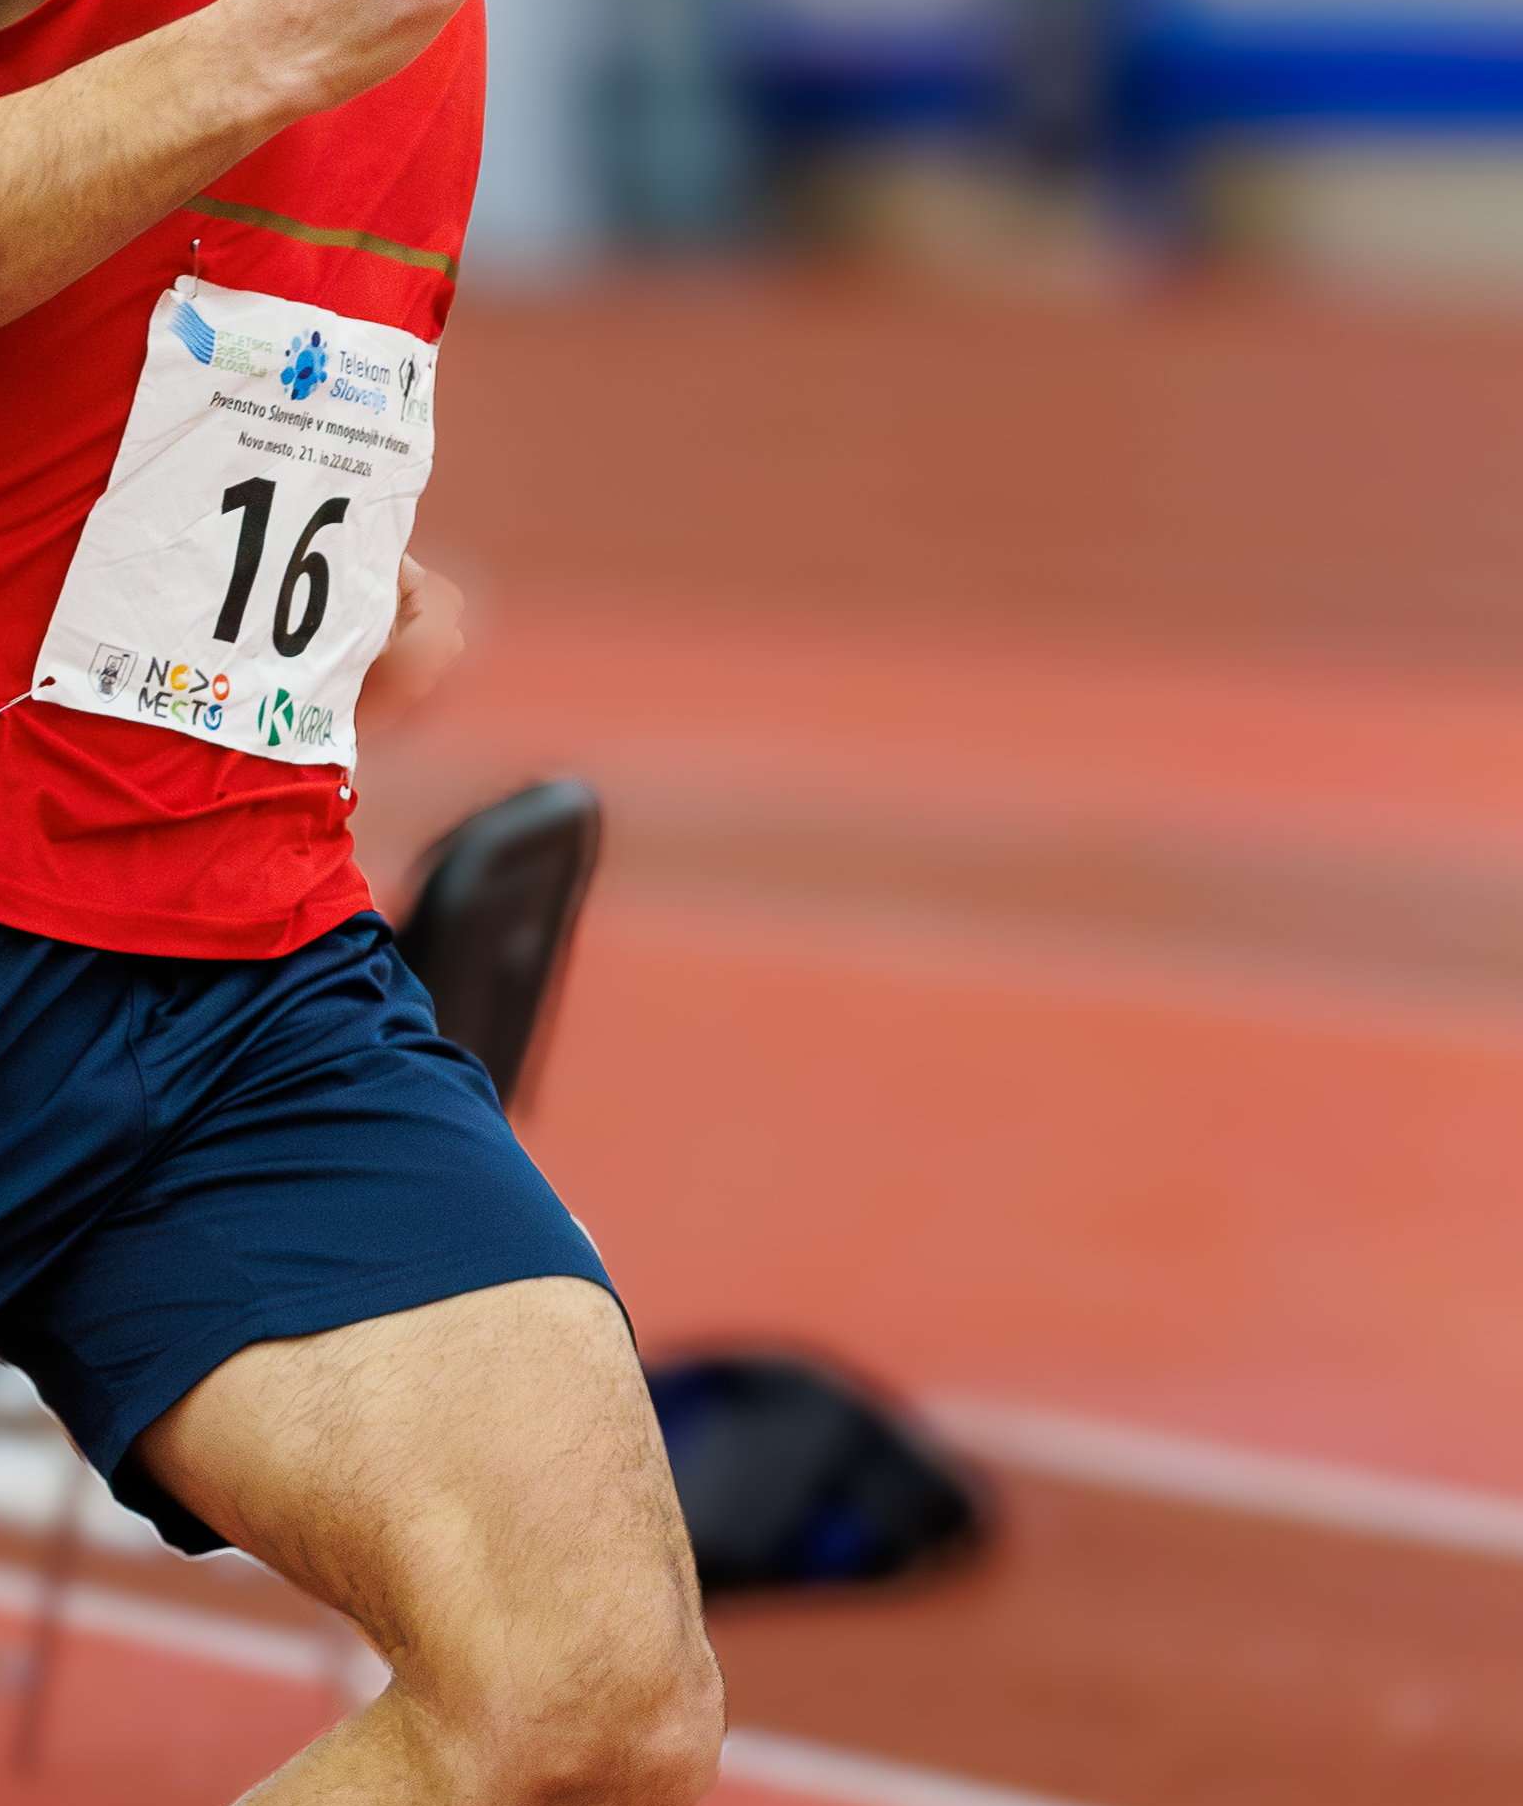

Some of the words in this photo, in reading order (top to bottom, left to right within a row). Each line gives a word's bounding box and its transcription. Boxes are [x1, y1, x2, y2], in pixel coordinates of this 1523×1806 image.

[339, 350, 391, 385] Telekom
[208, 390, 266, 418] Prvenstvo
[268, 403, 314, 432] Slovenije
[316, 419, 324, 431] v
[237, 430, 263, 450] Novo
[264, 439, 296, 460] mesto,
[299, 445, 317, 463] 21.
[212, 476, 351, 658] 16
[295, 702, 337, 747] KRKA
